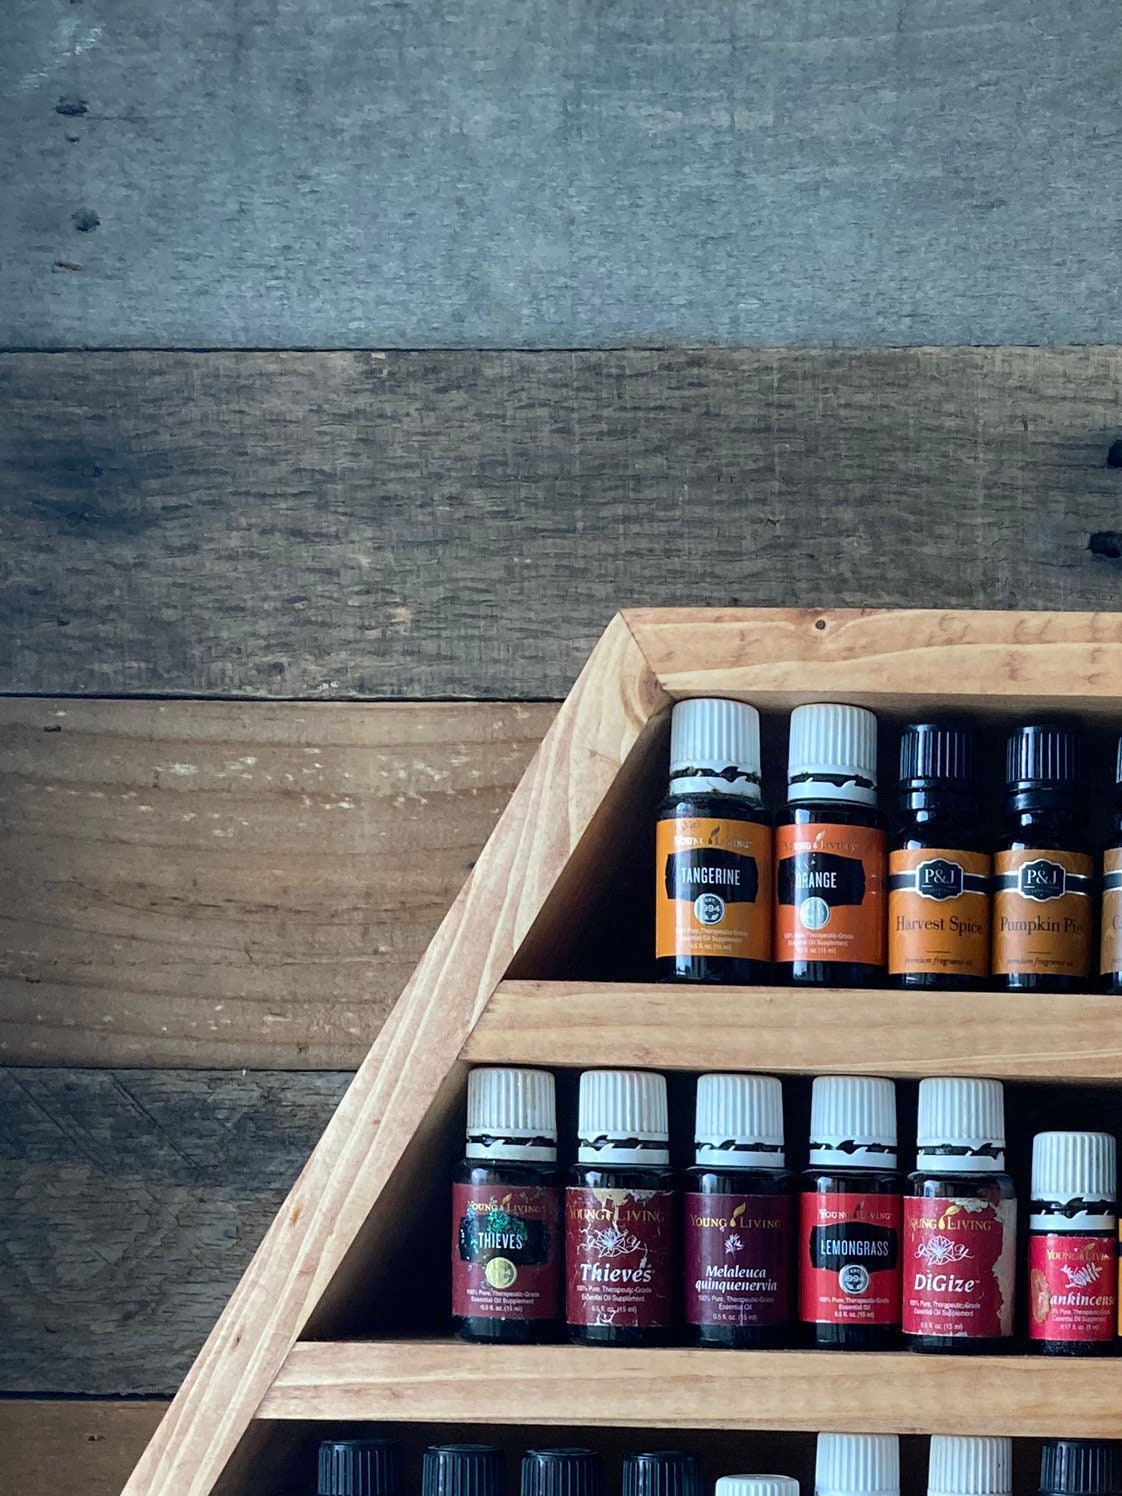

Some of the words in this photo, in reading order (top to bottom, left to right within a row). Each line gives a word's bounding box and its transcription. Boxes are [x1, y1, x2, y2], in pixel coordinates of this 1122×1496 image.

[681, 867, 741, 886] TANGERINE
[796, 872, 837, 888] ORANGE
[925, 869, 955, 884] P&J
[1027, 869, 1057, 884] P&J
[896, 916, 945, 931] Harvest
[949, 916, 983, 936] Spice
[1001, 916, 1060, 935] Pumpkin
[690, 1214, 727, 1227] YOUNG
[740, 1217, 781, 1228] LIVING
[947, 1216, 991, 1230] LIVING
[478, 1232, 523, 1250] THIEVES
[820, 1239, 889, 1256] LEMONGRASS
[580, 1262, 652, 1283] Thieves
[705, 1265, 767, 1278] Melaleuca
[695, 1278, 777, 1293] quinquenervia
